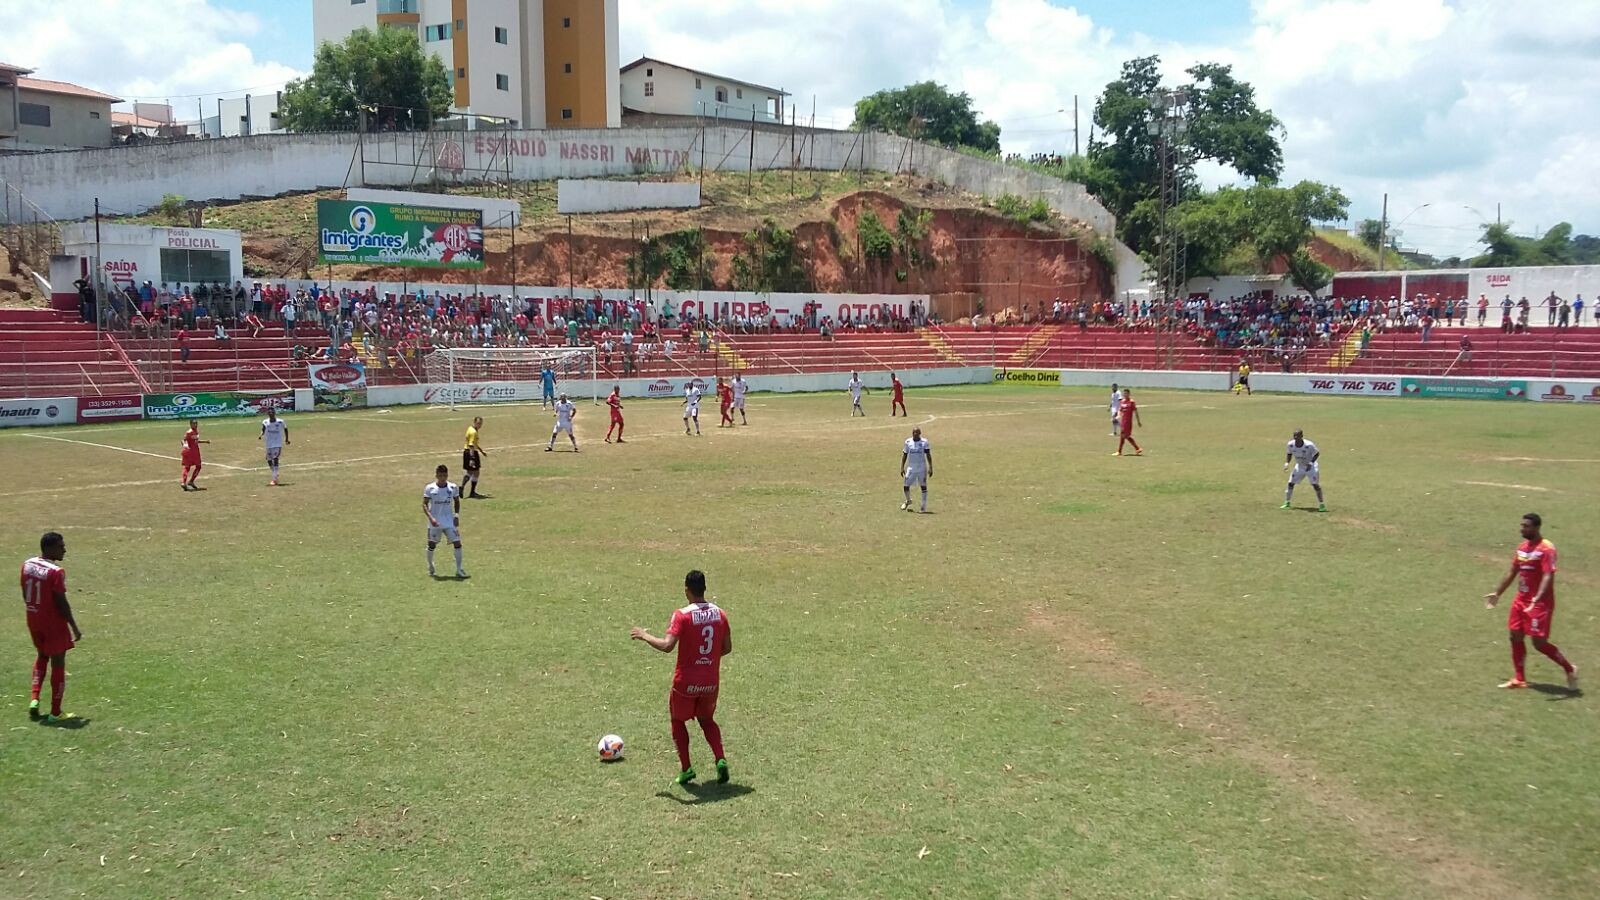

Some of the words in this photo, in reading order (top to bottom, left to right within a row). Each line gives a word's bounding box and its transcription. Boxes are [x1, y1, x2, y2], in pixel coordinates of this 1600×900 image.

[560, 142, 614, 162] NASSRI
[625, 147, 689, 166] MATTAR
[167, 229, 190, 237] Posto
[168, 237, 219, 248] POLICIAL
[323, 229, 402, 249] imigrantes
[106, 259, 138, 272] SAÍDA
[1486, 273, 1511, 283] SAÍDA
[1006, 372, 1036, 381] Coelho
[1037, 372, 1060, 381] Diniz
[440, 388, 468, 397] Certo
[486, 386, 515, 396] Certo
[648, 384, 675, 392] Rhumy
[25, 579, 41, 605] 11
[699, 625, 714, 655] 3
